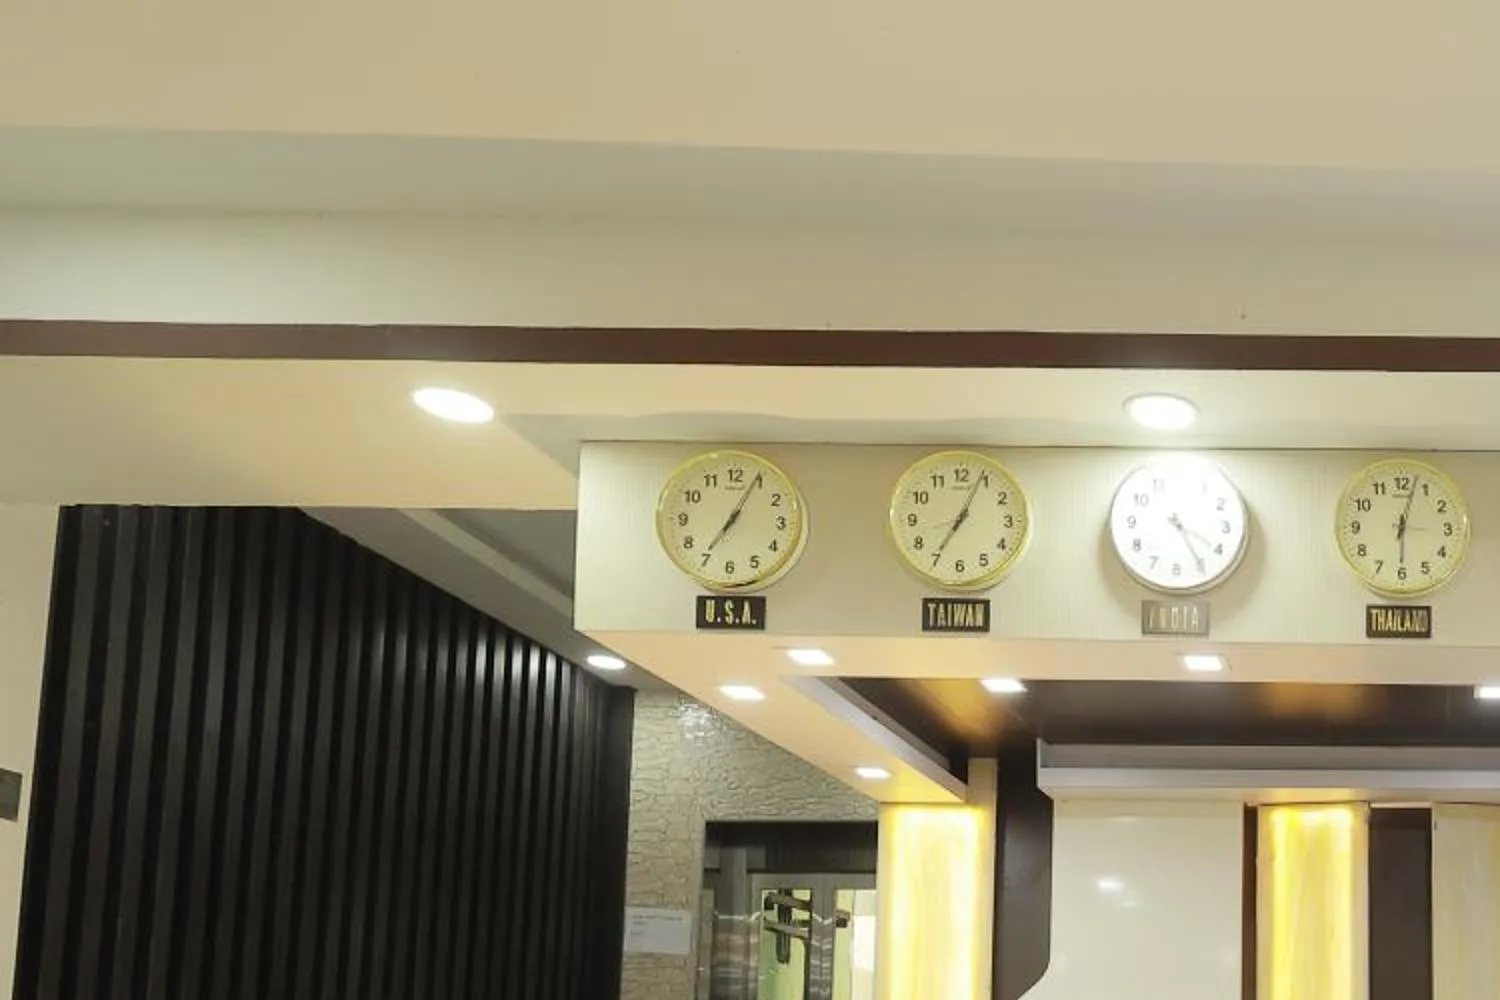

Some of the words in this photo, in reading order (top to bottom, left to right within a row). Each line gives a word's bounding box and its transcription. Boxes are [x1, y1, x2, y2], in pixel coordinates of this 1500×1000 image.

[703, 474, 718, 487] 11
[727, 469, 743, 482] 12
[930, 475, 945, 487] 11
[954, 469, 969, 482] 12
[983, 475, 989, 488] 1
[1373, 482, 1386, 495] 11
[1394, 477, 1409, 491] 12
[1422, 484, 1428, 496] 1
[684, 490, 701, 503] 10
[771, 493, 781, 507] 2
[913, 491, 929, 504] 10
[997, 491, 1008, 505] 2
[1133, 492, 1149, 507] 10
[1216, 497, 1226, 511] 2
[1355, 498, 1371, 512] 10
[1437, 500, 1447, 513] 2
[677, 512, 688, 526] 9
[775, 516, 786, 530] 3
[907, 513, 918, 527] 9
[1003, 515, 1013, 529] 3
[1126, 514, 1137, 529] 9
[1221, 520, 1231, 534] 3
[1351, 520, 1361, 534] 9
[1443, 522, 1453, 536] 3
[683, 536, 694, 549] 8
[768, 539, 778, 552] 4
[914, 536, 924, 549] 8
[996, 537, 1007, 550] 4
[1132, 538, 1142, 552] 8
[1213, 543, 1224, 555] 4
[1357, 543, 1367, 557] 8
[1437, 545, 1447, 558] 4
[701, 553, 711, 566] 7
[750, 555, 759, 568] 5
[931, 553, 941, 567] 7
[955, 559, 965, 573] 6
[979, 554, 989, 567] 5
[1148, 555, 1159, 569] 7
[725, 560, 734, 574] 6
[1374, 560, 1383, 573] 7
[1421, 561, 1430, 574] 5
[1397, 567, 1407, 580] 6
[705, 599, 757, 624] U.S.A.
[927, 602, 985, 627] TAIWAN
